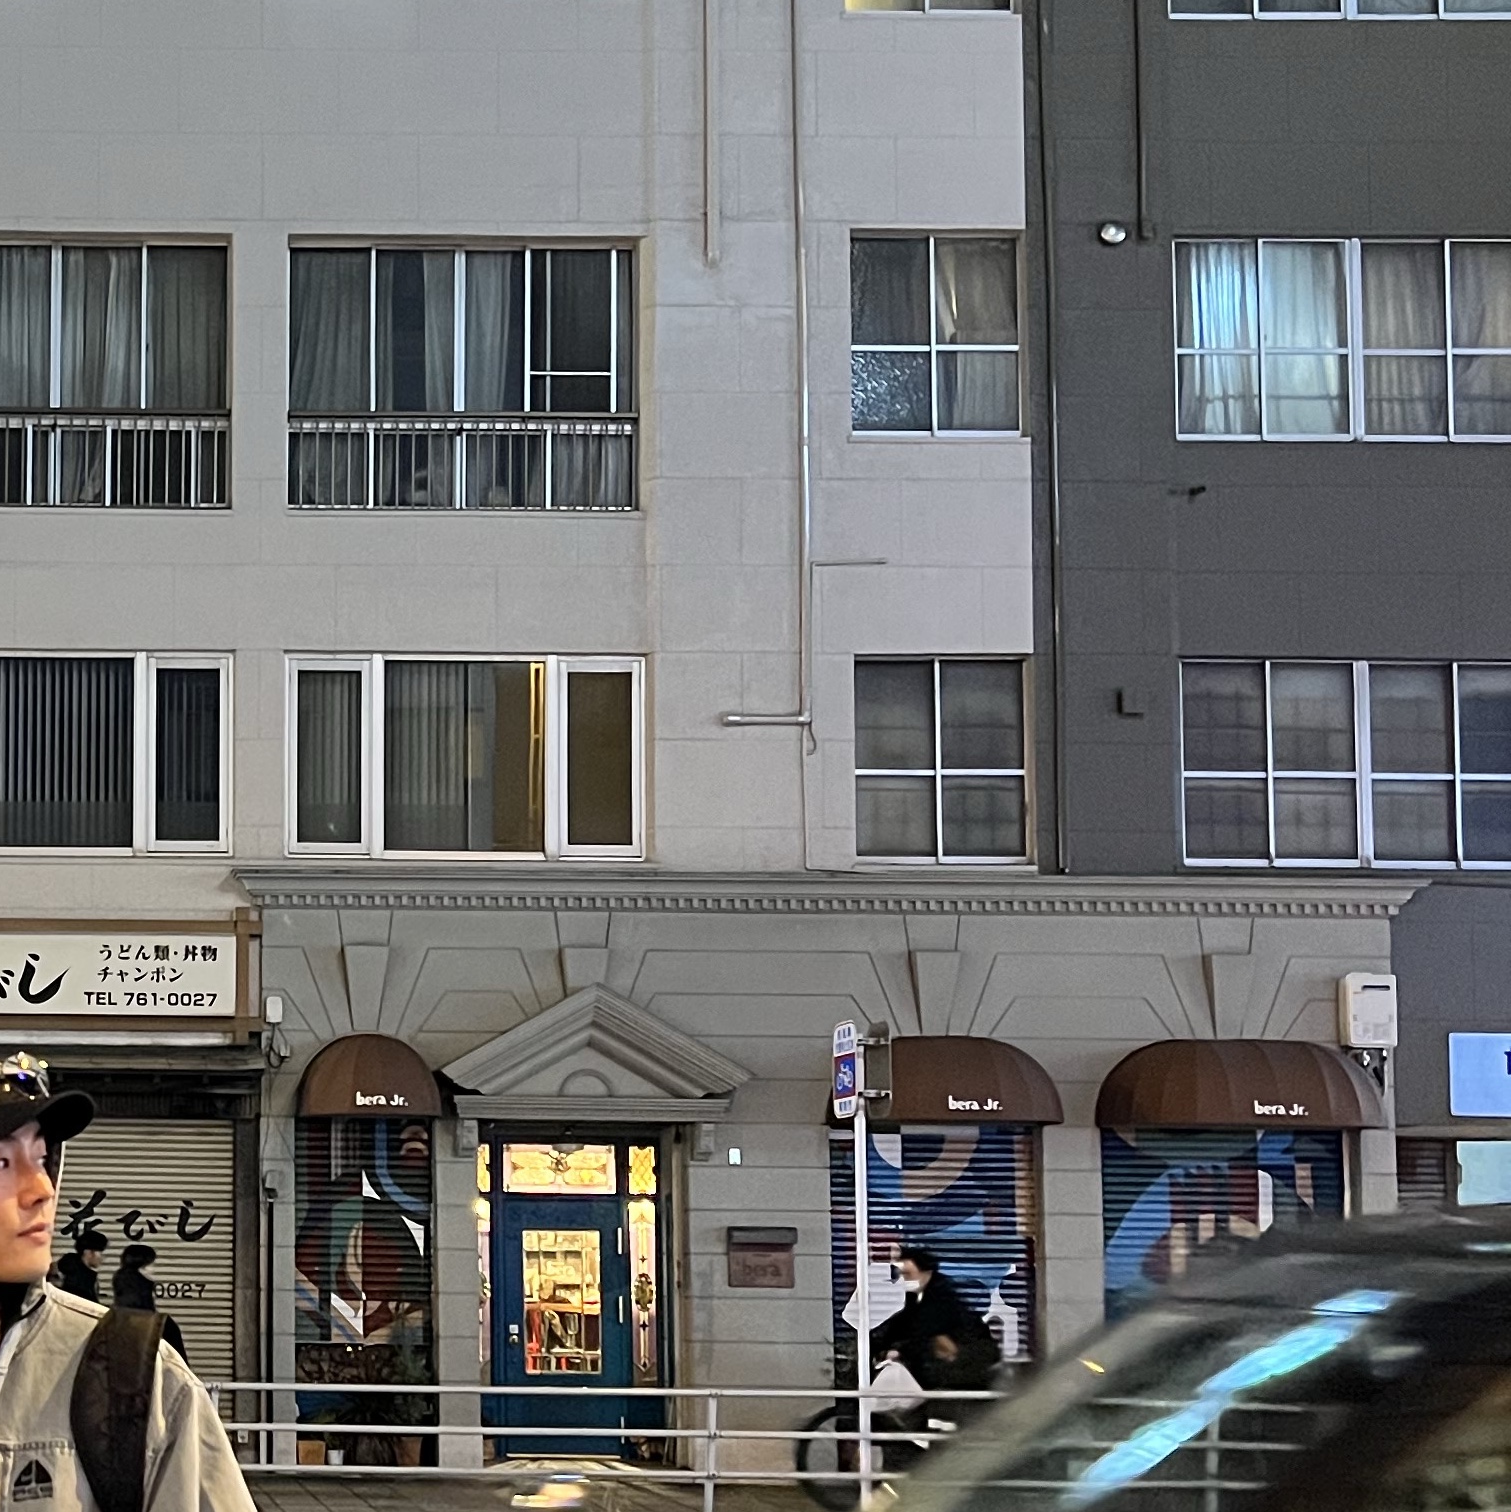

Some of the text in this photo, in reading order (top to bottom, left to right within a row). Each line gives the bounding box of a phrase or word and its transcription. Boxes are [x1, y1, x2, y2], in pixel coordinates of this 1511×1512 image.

[97, 965, 184, 983] チャンポン
[83, 991, 218, 1007] TEL 761-0027
[355, 1090, 409, 1107] bera Jr.
[948, 1094, 1004, 1111] bera Jr.
[1253, 1099, 1309, 1116] bera Jr.
